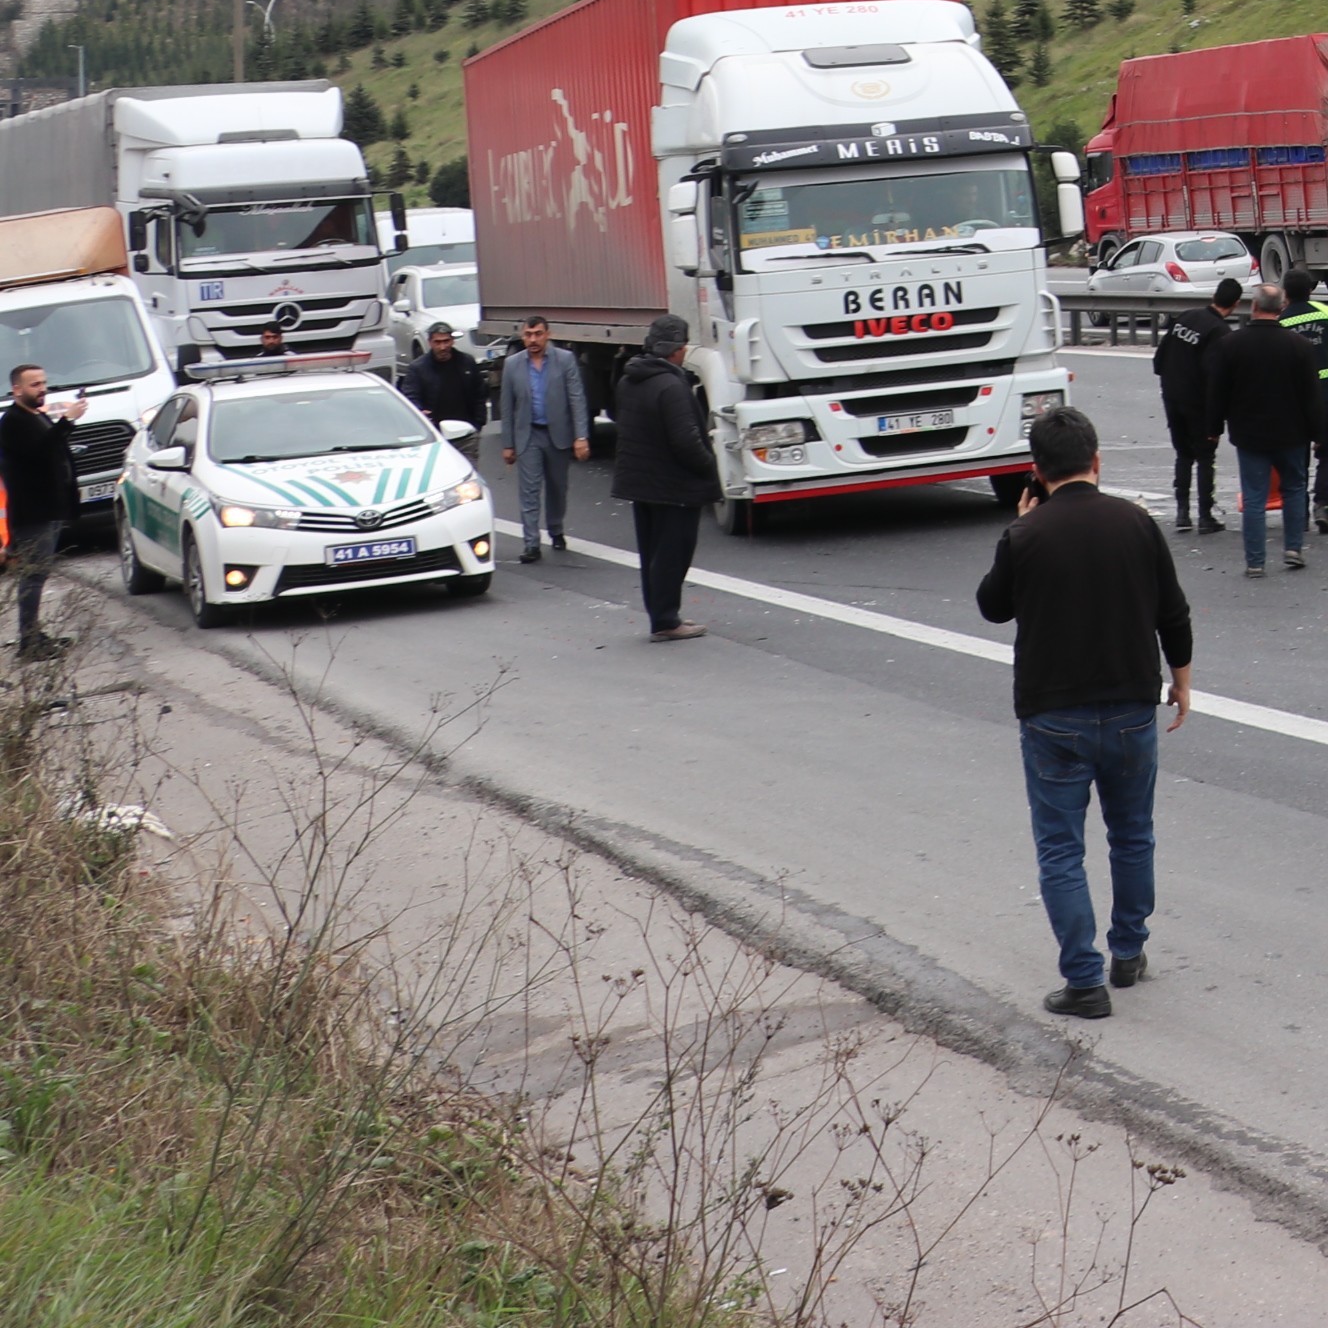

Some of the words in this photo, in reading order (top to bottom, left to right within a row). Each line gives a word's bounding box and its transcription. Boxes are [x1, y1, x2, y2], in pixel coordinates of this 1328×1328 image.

[785, 9, 805, 18] 41
[813, 6, 840, 15] YE
[847, 5, 879, 14] 280
[810, 260, 989, 286] STRALIS
[201, 283, 223, 300] TIR
[843, 281, 963, 314] BERAN
[853, 312, 955, 339] IVECO
[1290, 323, 1324, 336] RAFİK
[886, 418, 900, 431] 41
[909, 416, 922, 428] YE
[931, 413, 950, 426] 280
[253, 457, 339, 475] OTOYOL
[335, 548, 351, 560] 41
[357, 546, 369, 558] A
[372, 541, 409, 556] 5954
